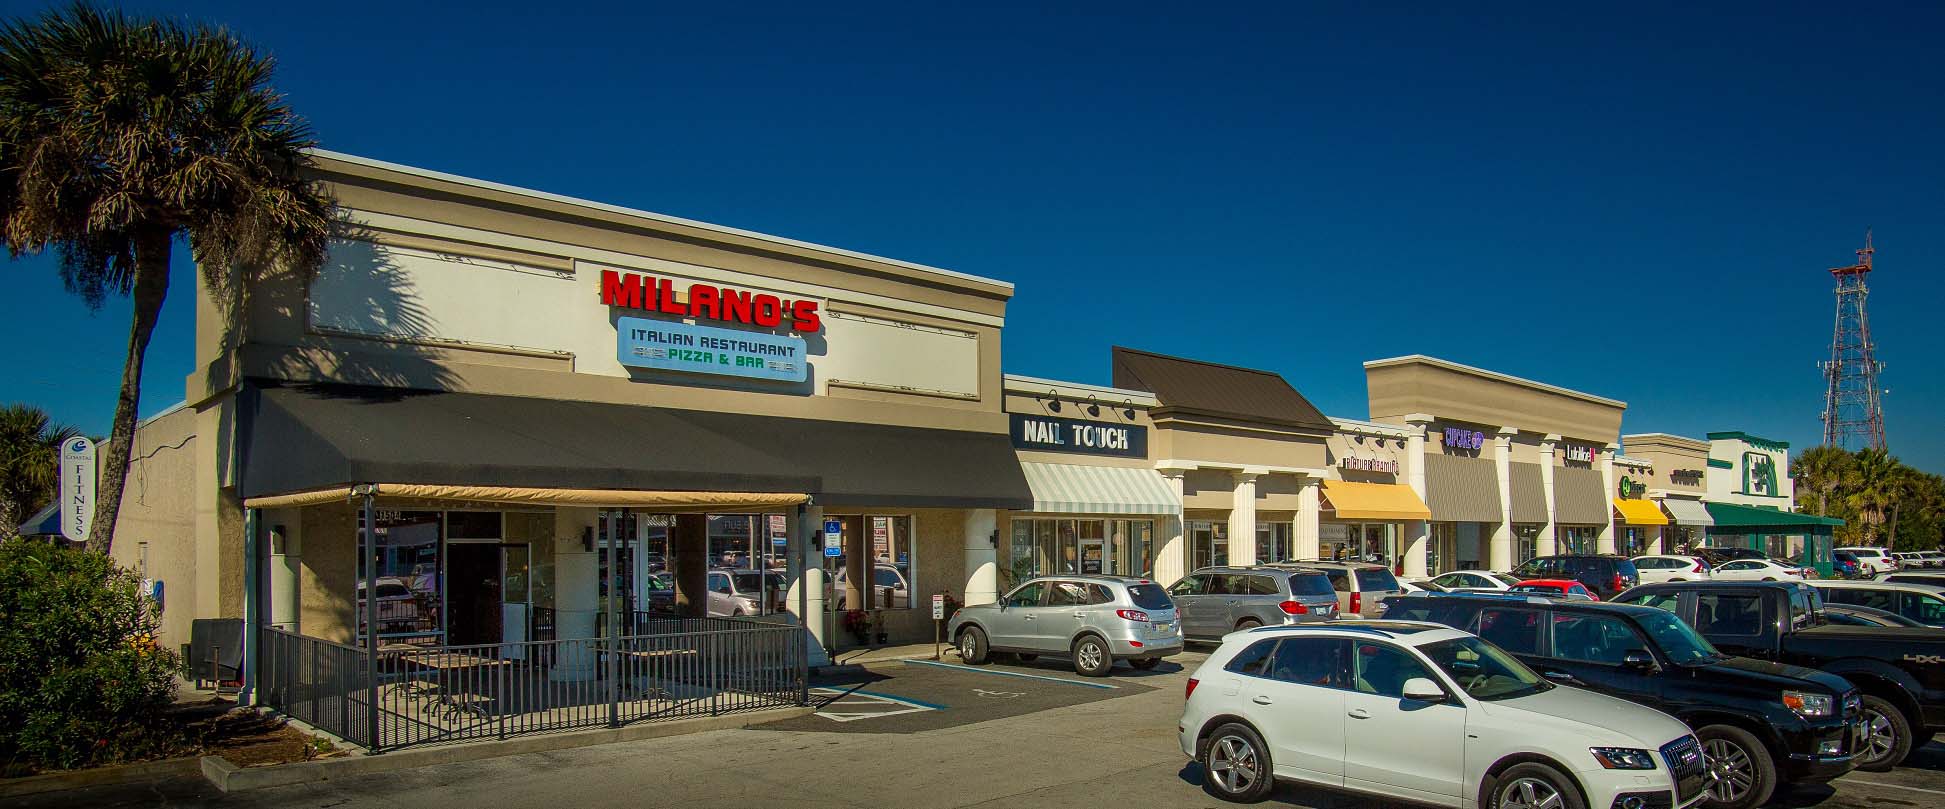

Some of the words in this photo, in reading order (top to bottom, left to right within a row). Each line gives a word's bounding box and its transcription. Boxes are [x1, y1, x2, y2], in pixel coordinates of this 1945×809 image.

[600, 269, 821, 333] MILANO'S
[631, 328, 694, 346] ITALIAN
[700, 336, 796, 358] RESTAURANT
[668, 348, 713, 364] PIZZA
[719, 353, 729, 365] &
[735, 355, 764, 369] BAR
[1024, 420, 1065, 445] NAIL
[1072, 424, 1129, 449] TOUCH
[1445, 427, 1472, 449] CUPCAKE
[73, 464, 85, 536] FITNESS
